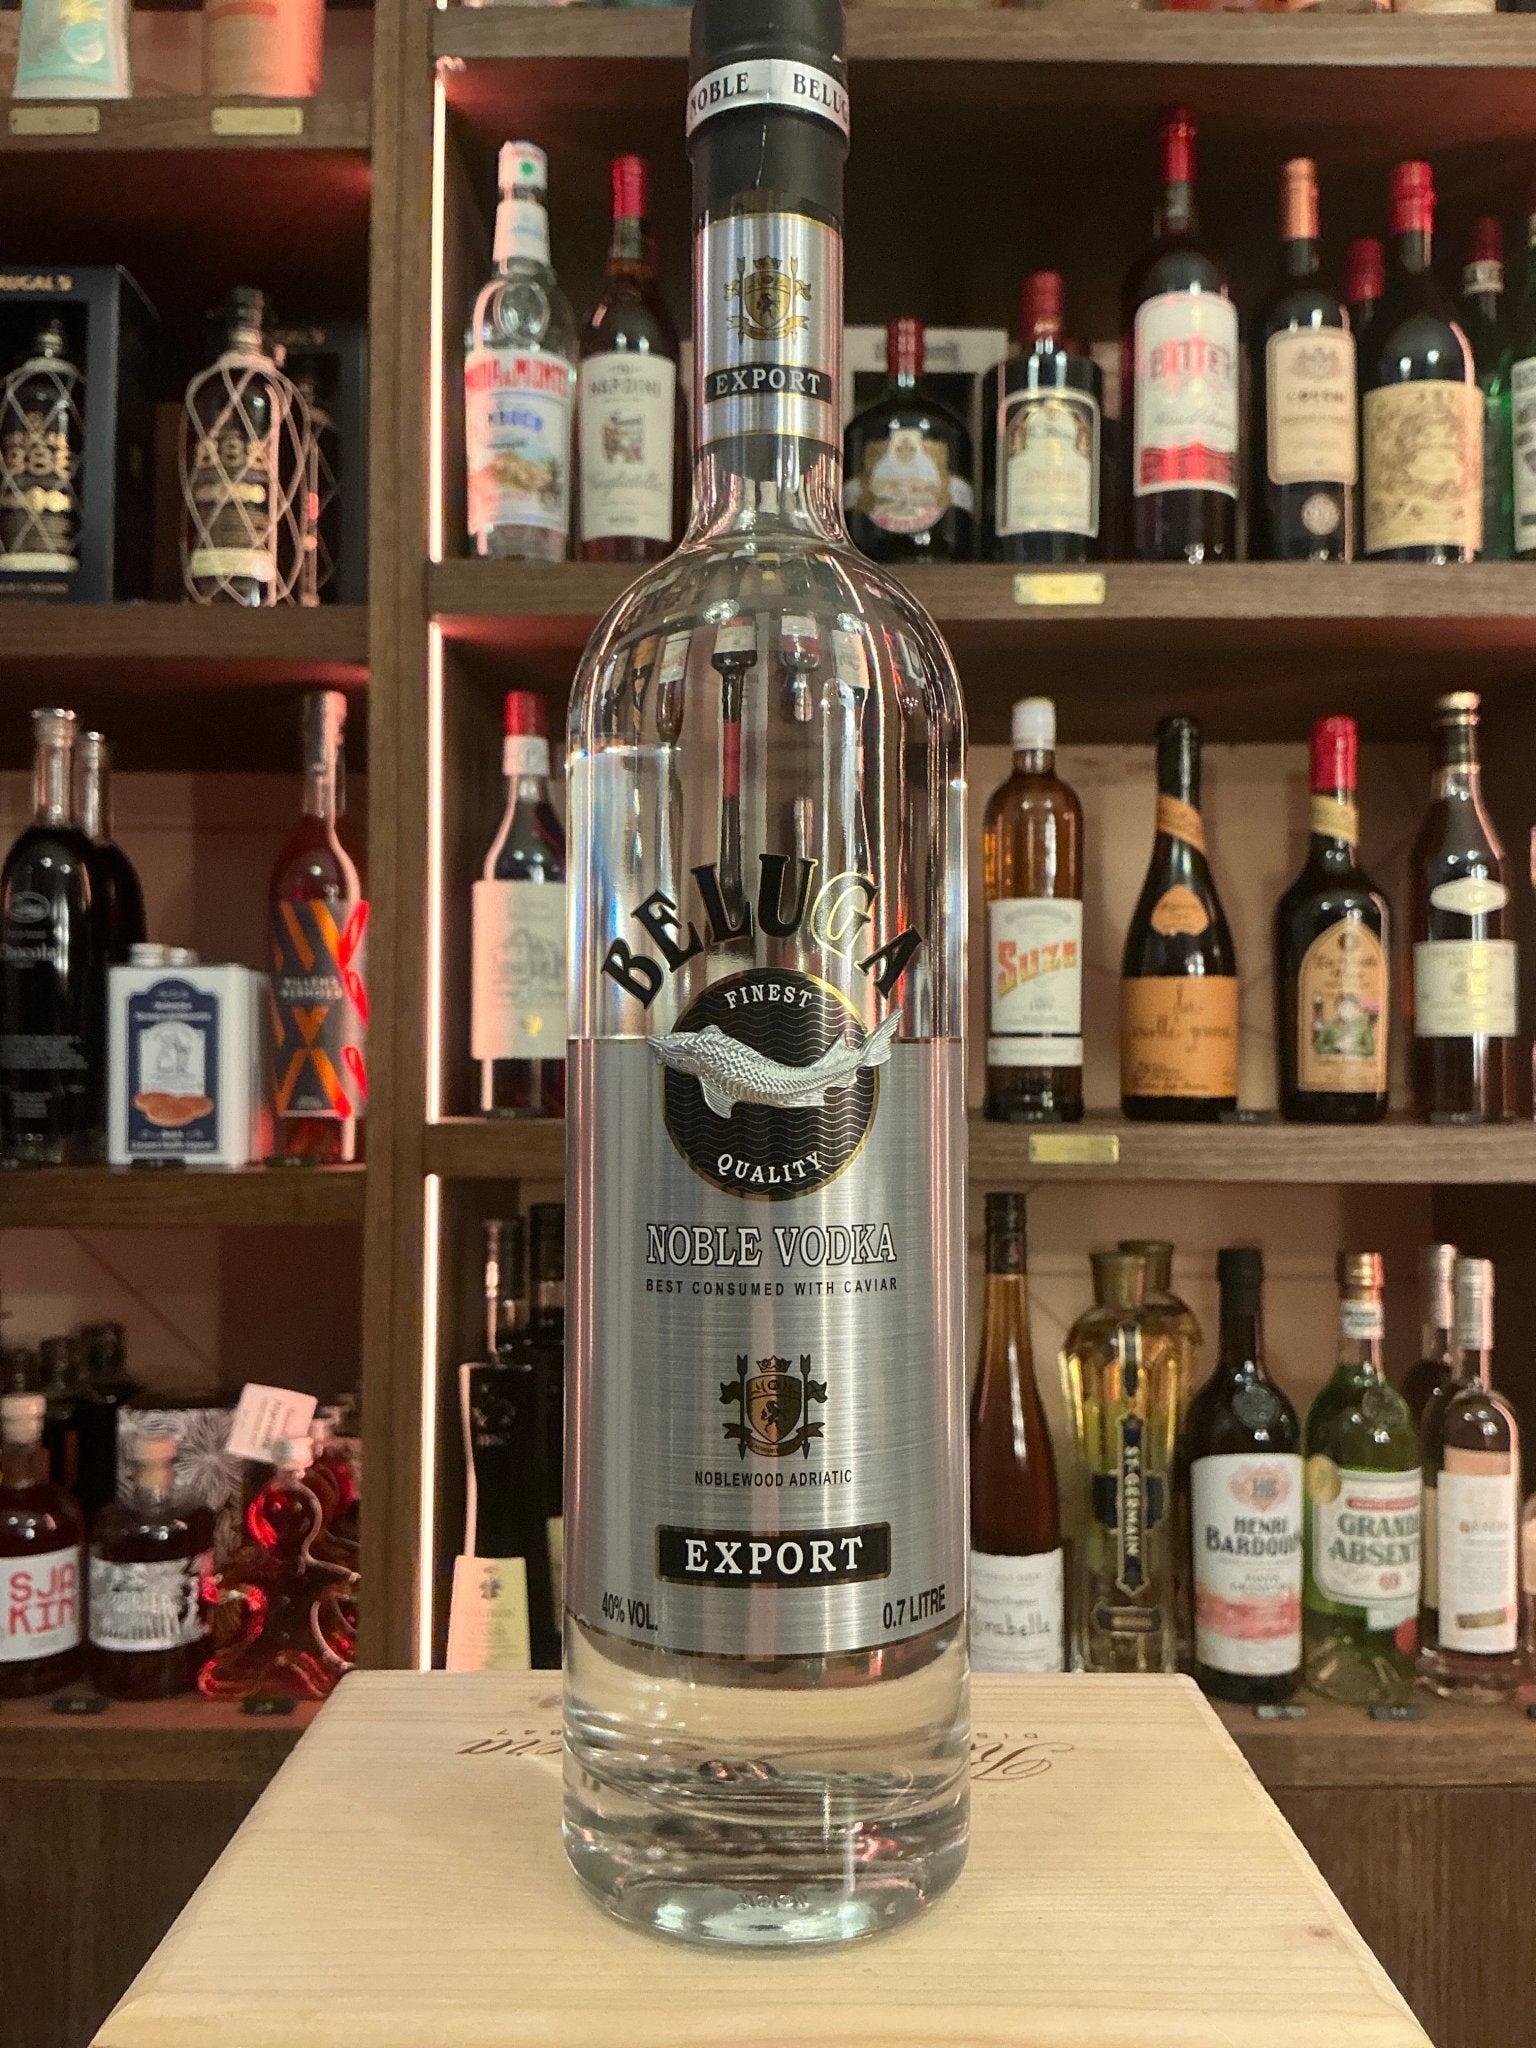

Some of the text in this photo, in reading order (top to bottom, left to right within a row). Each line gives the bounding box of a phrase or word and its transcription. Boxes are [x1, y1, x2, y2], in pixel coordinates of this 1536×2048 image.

[689, 72, 750, 117] NOBLE
[714, 368, 821, 395] EXPORT
[601, 853, 923, 1010] BELUGA
[997, 939, 1077, 1000] Suze
[723, 983, 814, 1010] FINEST
[716, 1150, 824, 1185] QUALITY
[646, 1223, 897, 1267] NOBLE VODKA
[646, 1276, 898, 1297] BEST CONSUMED WITH CAVIAR
[694, 1468, 853, 1488] NOBLEWOOD ADRIATIC
[684, 1534, 864, 1576] EXPORT
[601, 1590, 659, 1632] 40% VOL.
[882, 1598, 907, 1630] 0.7
[909, 1583, 947, 1623] LITRE
